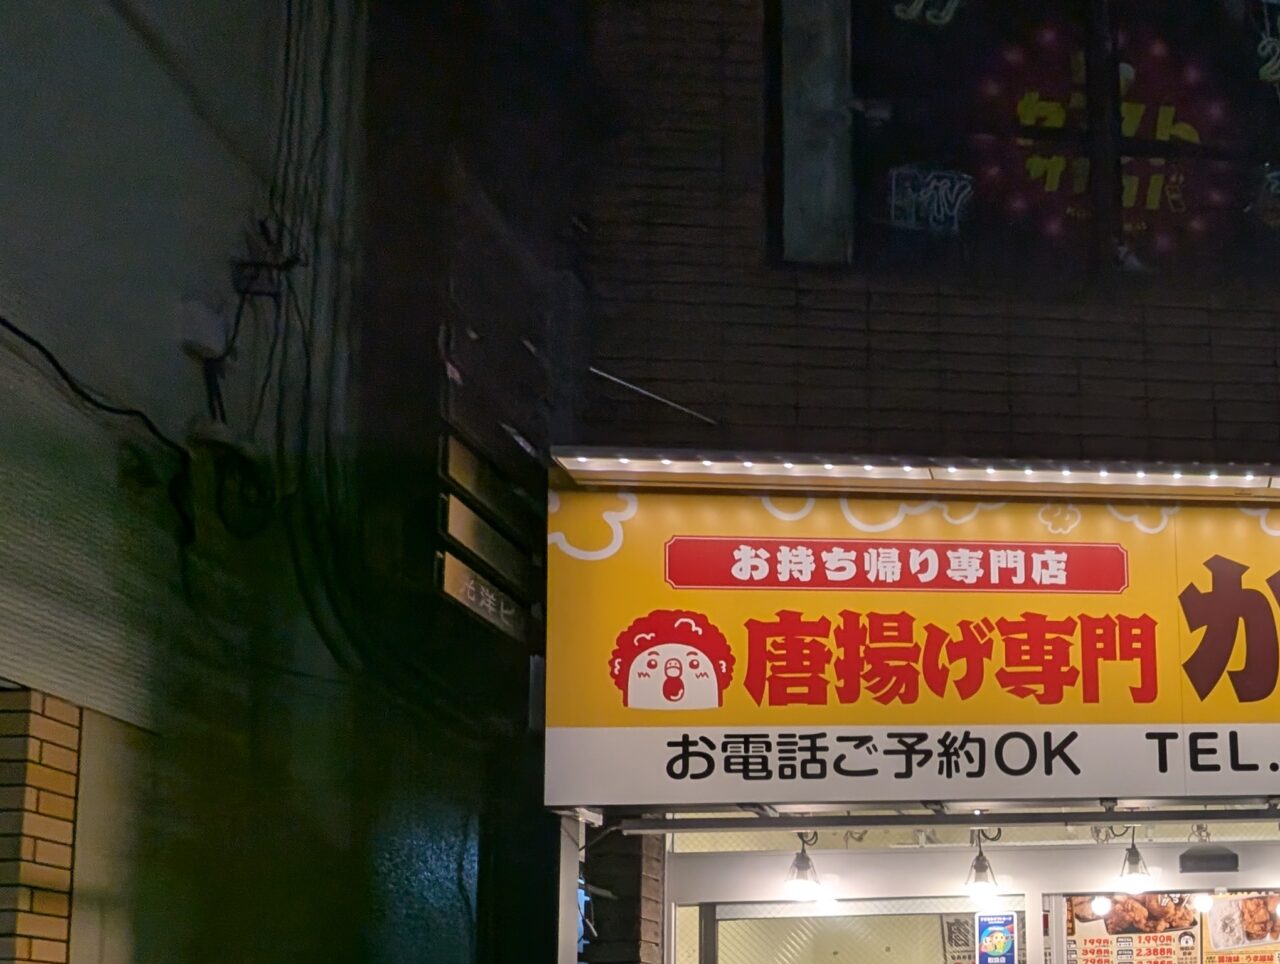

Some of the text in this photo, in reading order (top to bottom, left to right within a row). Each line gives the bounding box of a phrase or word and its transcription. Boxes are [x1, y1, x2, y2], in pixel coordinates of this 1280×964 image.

[730, 544, 1070, 586] お持ち帰り専門店
[743, 609, 1159, 708] 唐揚げ専門
[665, 731, 1081, 781] お電話ご予約OK
